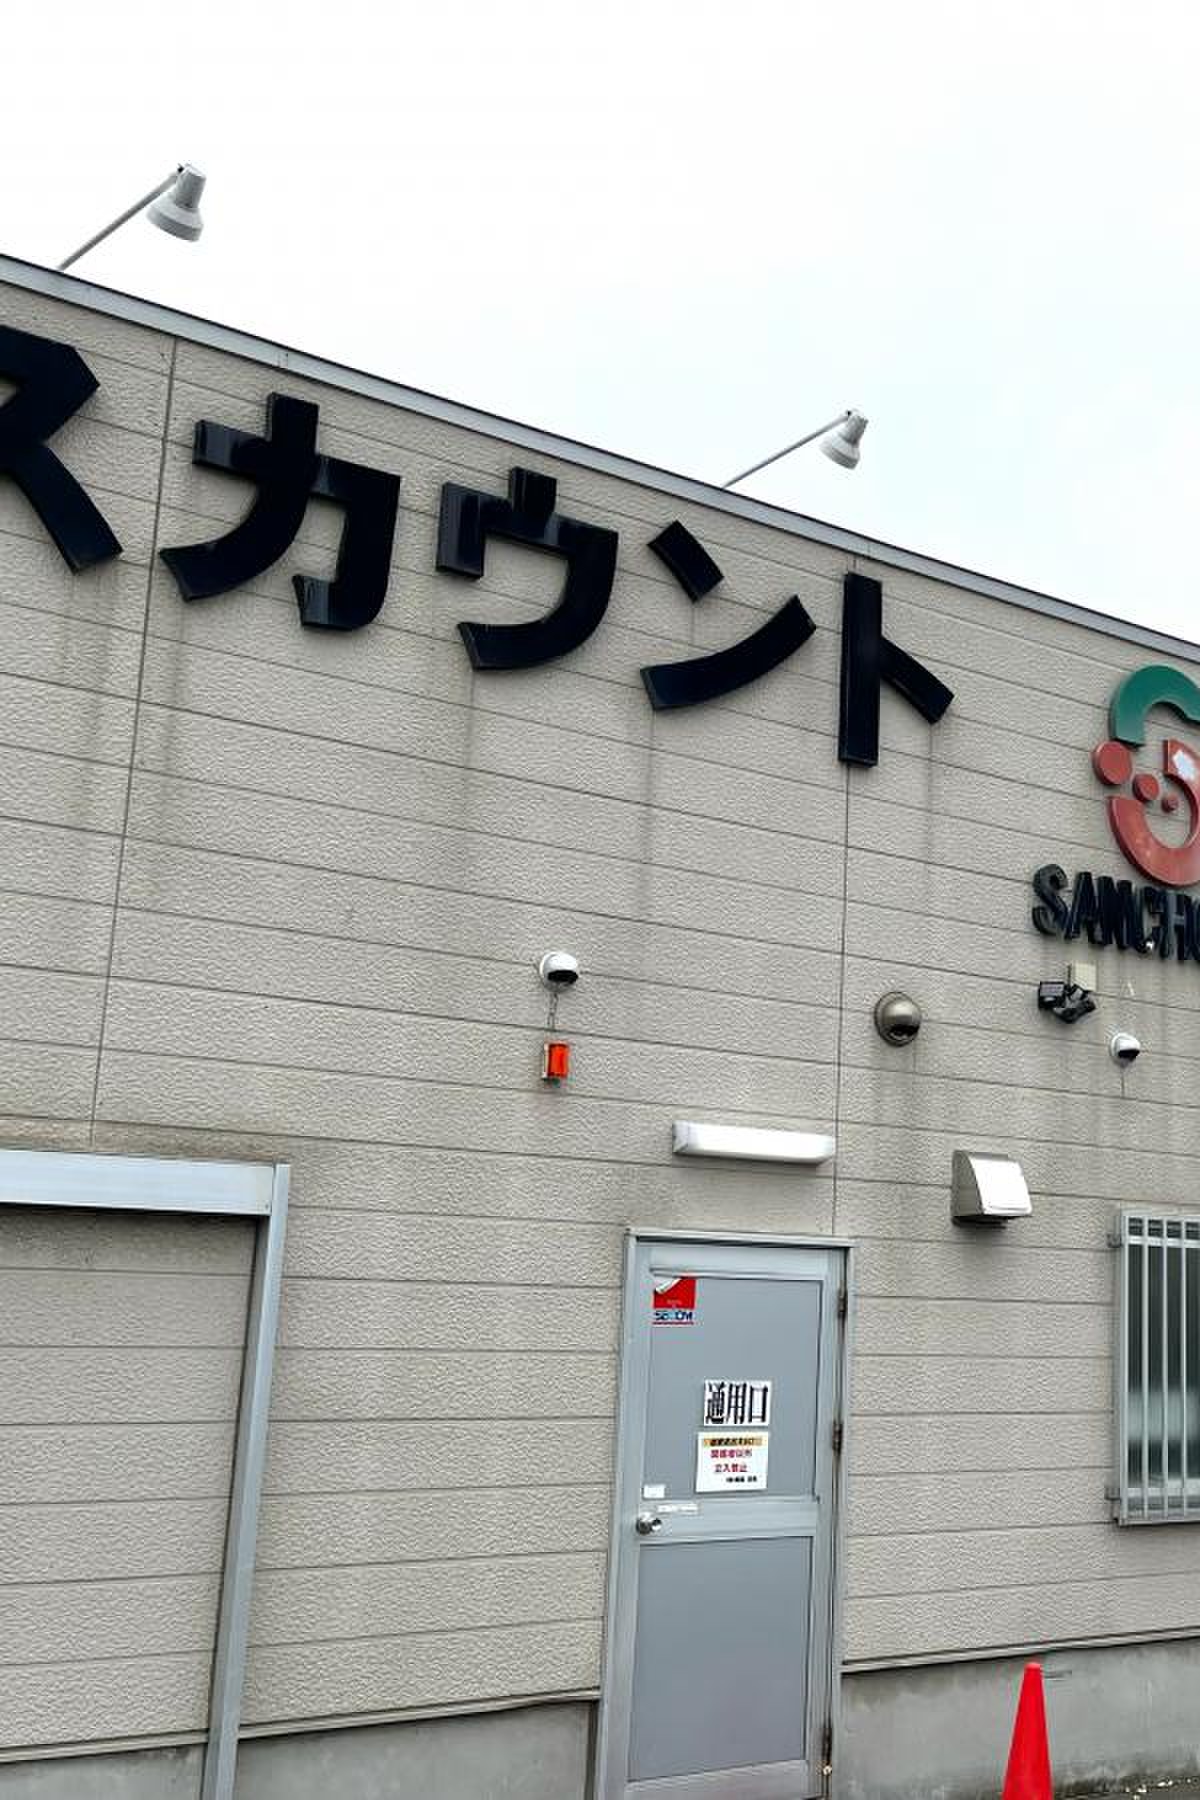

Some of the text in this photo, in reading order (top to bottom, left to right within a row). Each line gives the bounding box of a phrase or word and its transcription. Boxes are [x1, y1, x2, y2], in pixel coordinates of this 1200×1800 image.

[654, 1310, 693, 1321] SEOM
[704, 1381, 769, 1425] 通用口
